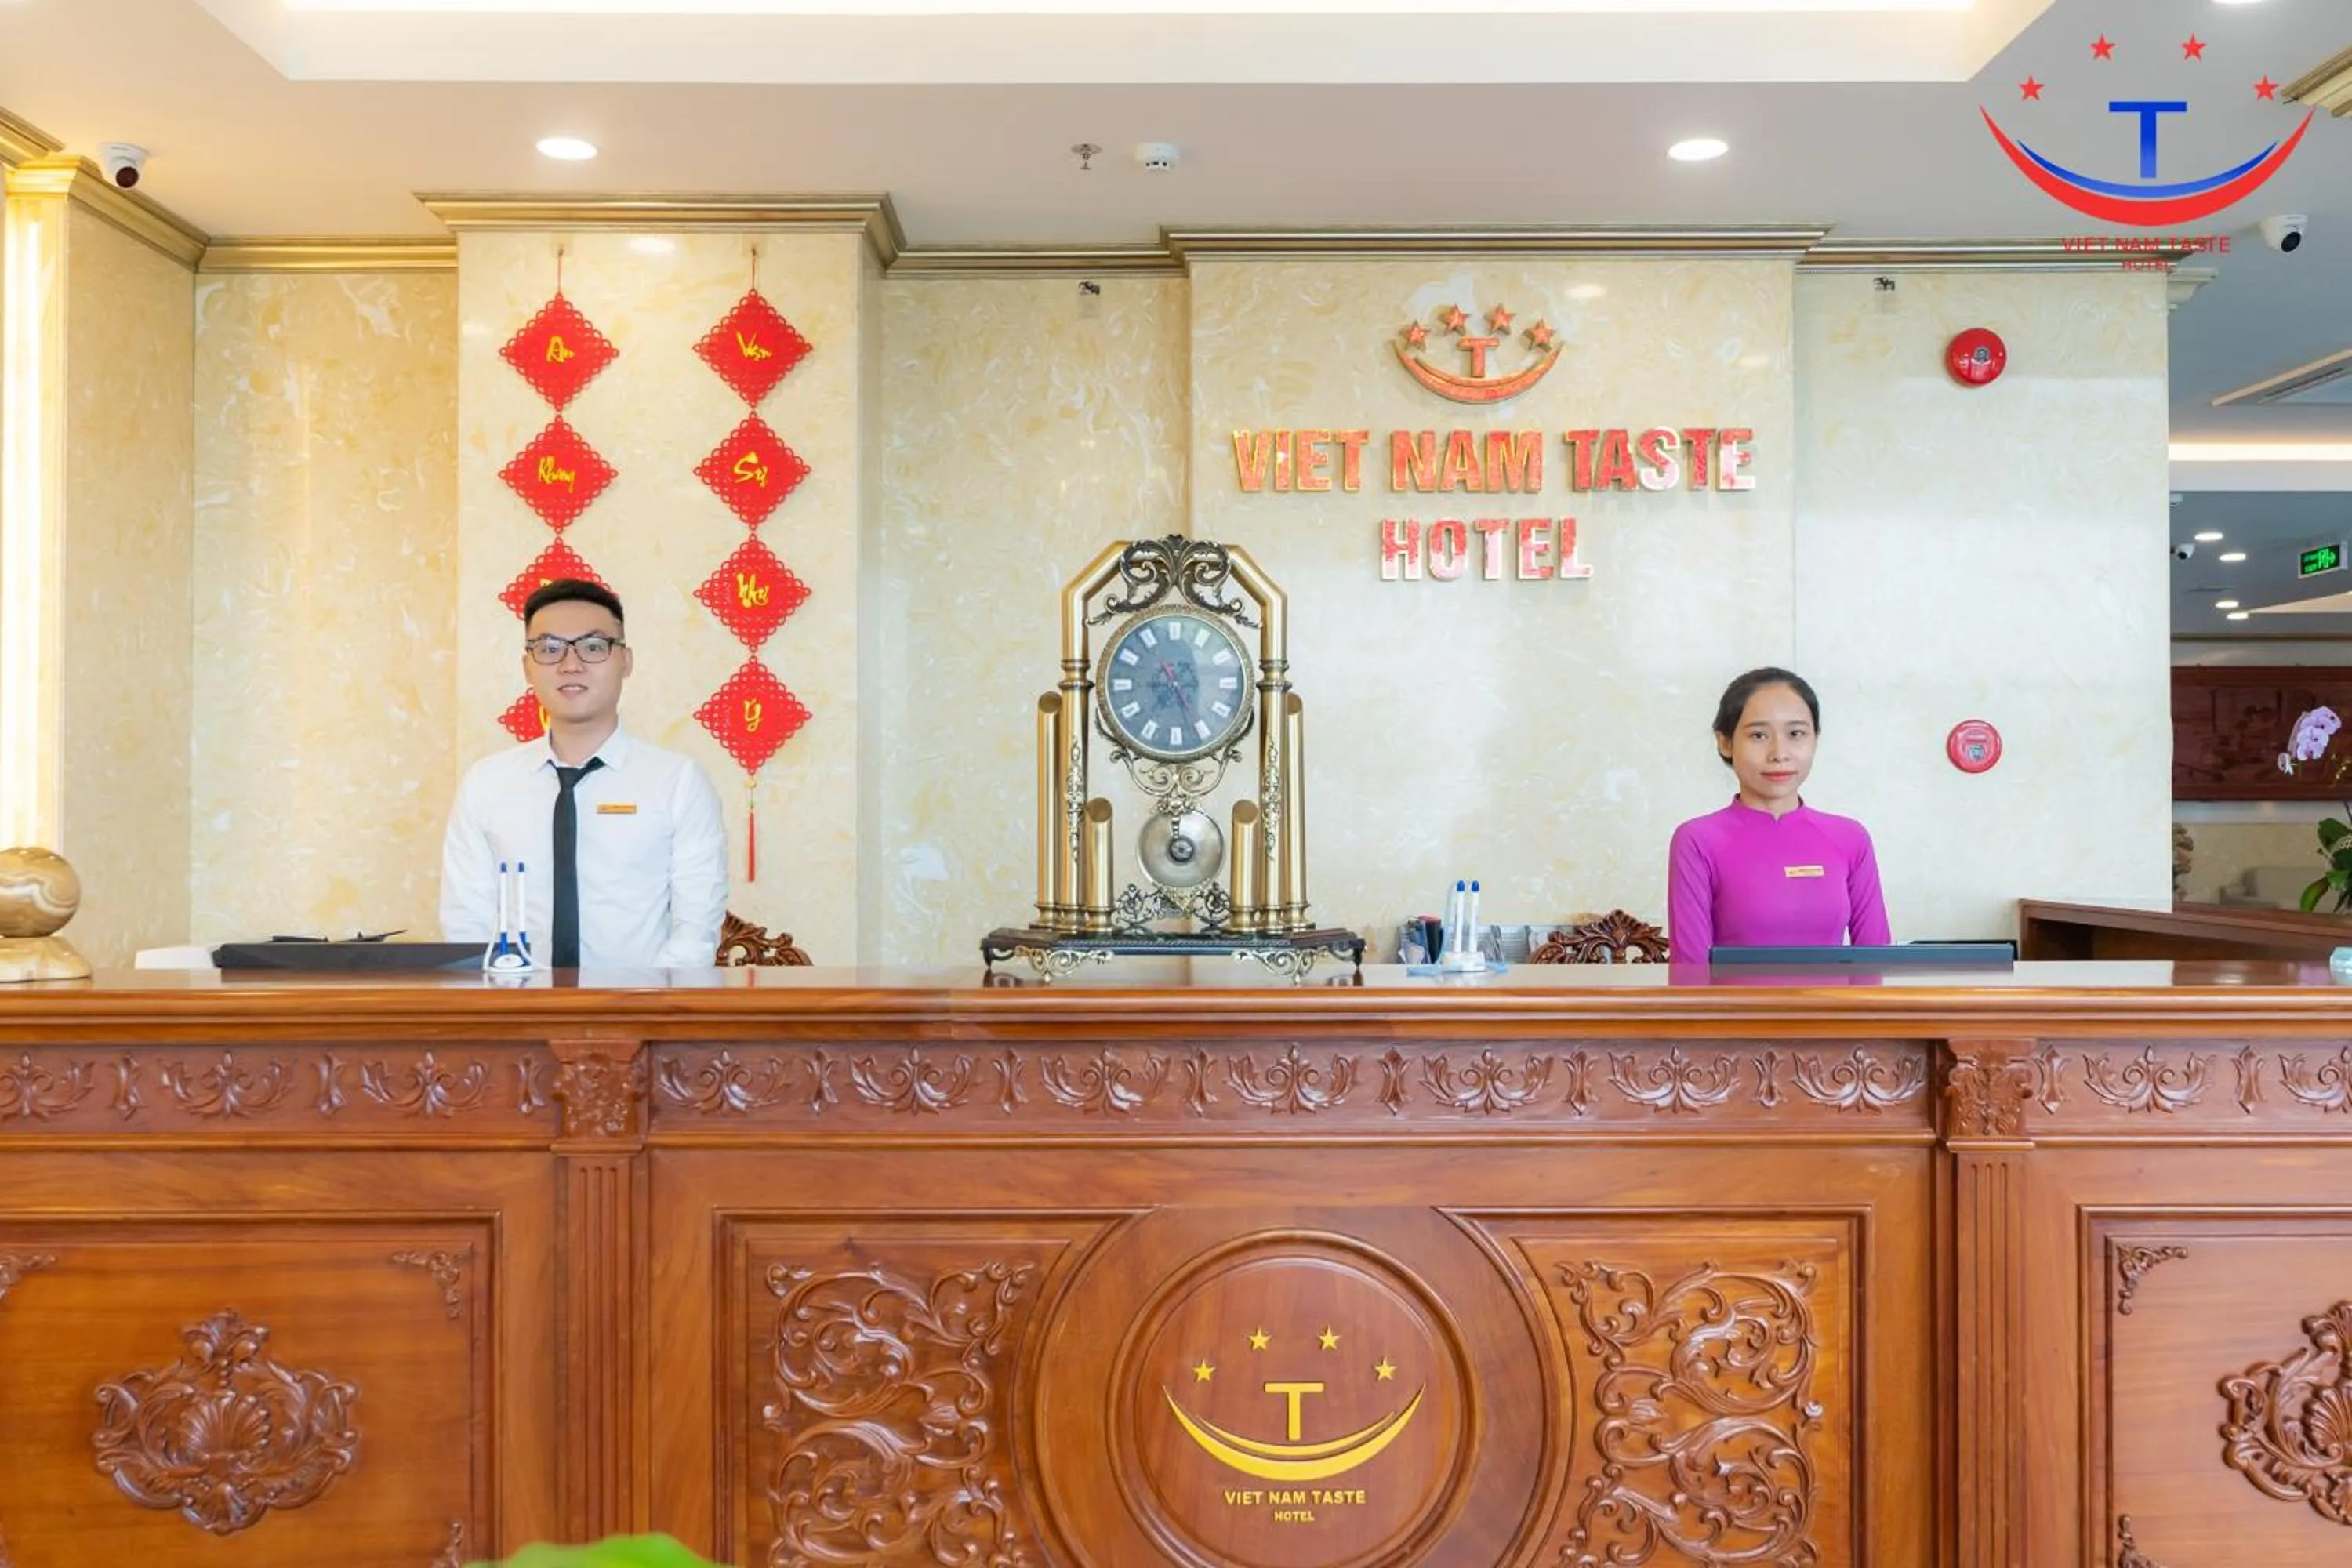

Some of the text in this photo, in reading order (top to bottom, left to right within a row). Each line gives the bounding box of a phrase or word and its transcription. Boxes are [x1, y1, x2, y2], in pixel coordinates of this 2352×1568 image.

[546, 336, 575, 363] An
[1456, 337, 1499, 378] T
[1232, 426, 1756, 492] VIET NAM TASTE
[1381, 516, 1594, 581] HOTEL
[1265, 1382, 1324, 1441] T
[1225, 1490, 1366, 1505] VIET NAM TASTE
[1274, 1510, 1315, 1523] HOTEL
